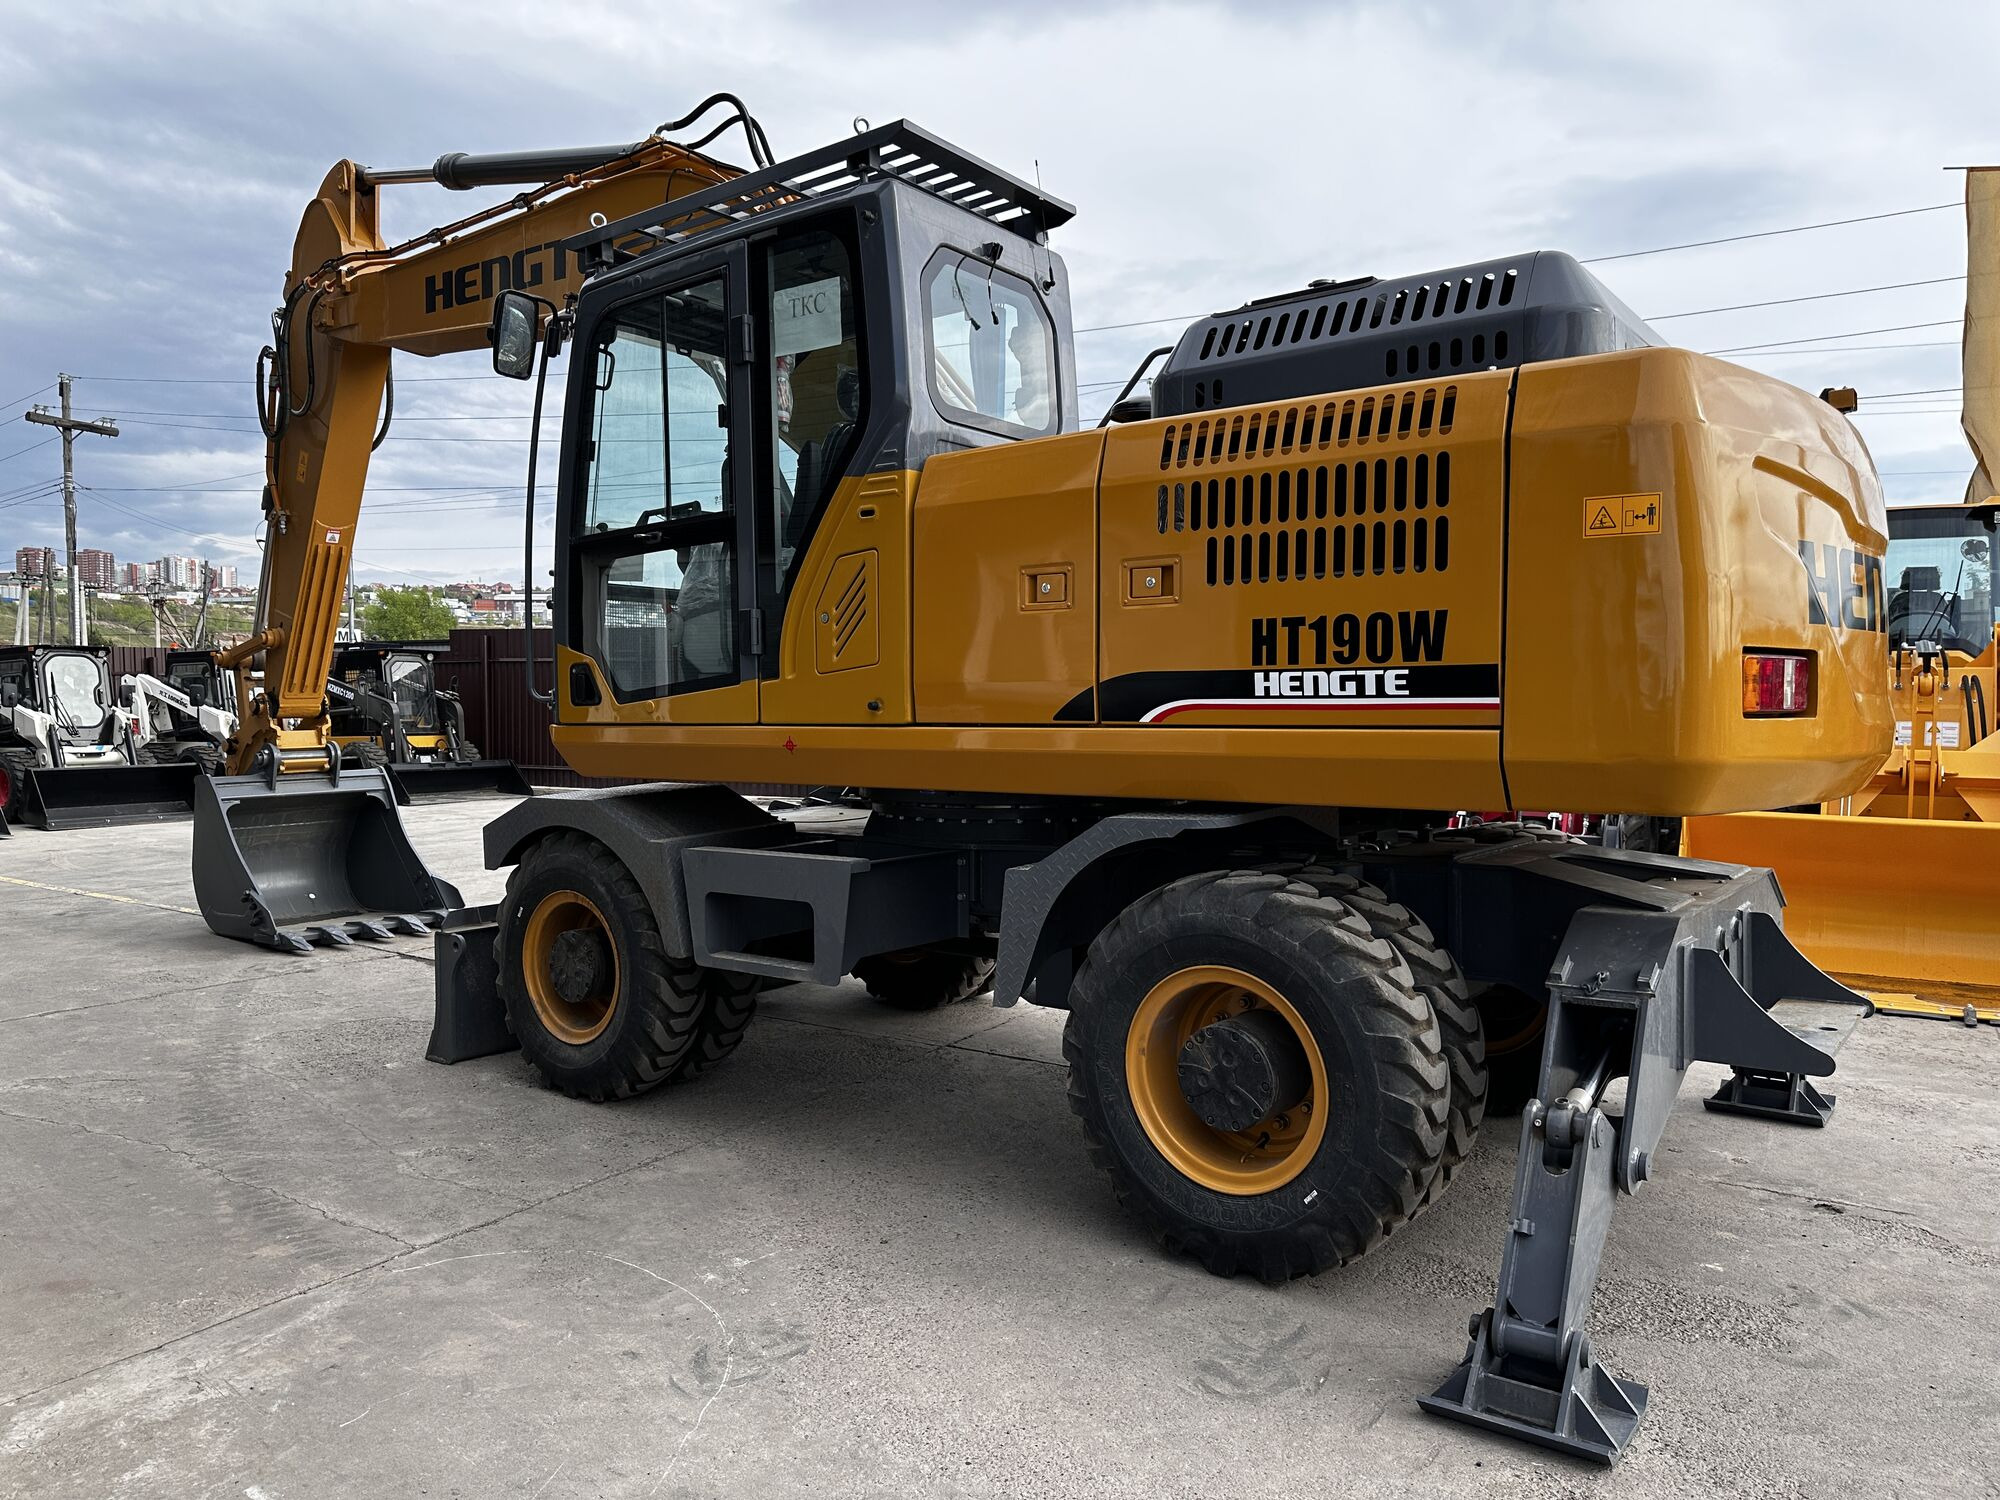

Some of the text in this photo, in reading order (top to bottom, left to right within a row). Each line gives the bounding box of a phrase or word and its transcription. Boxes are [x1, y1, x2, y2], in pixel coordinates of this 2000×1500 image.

[425, 239, 586, 314] HENGT
[1251, 609, 1448, 667] HT190W
[1254, 669, 1410, 697] HENGTE
